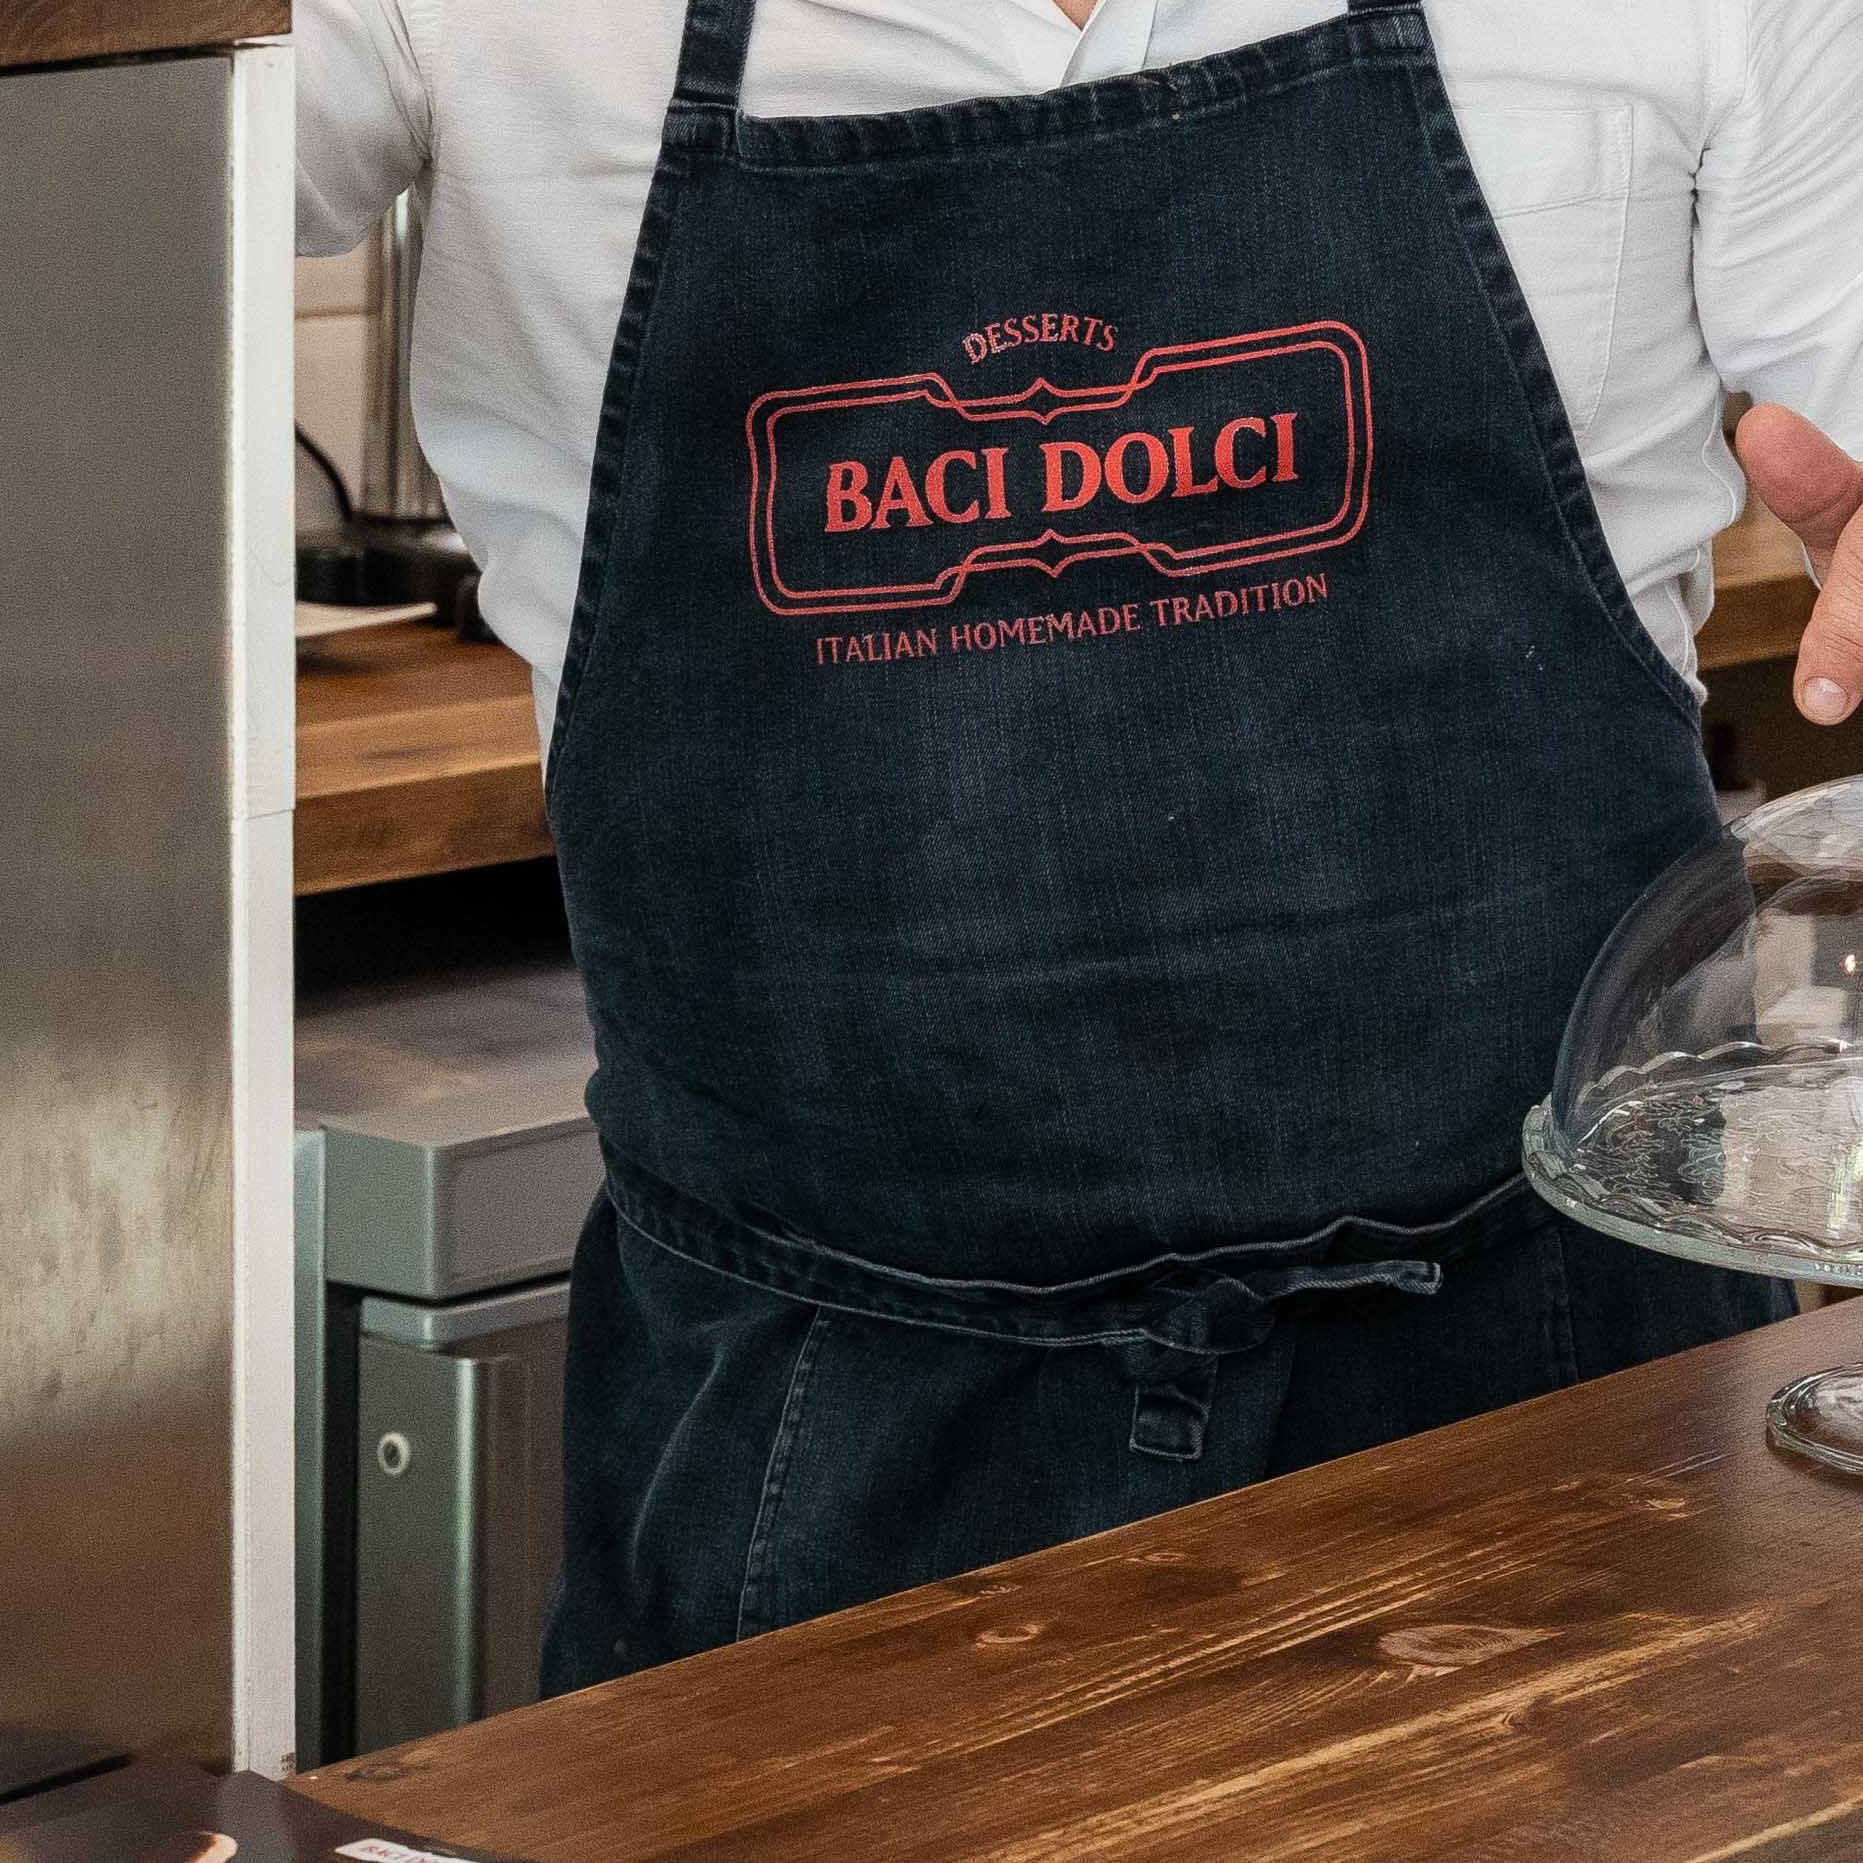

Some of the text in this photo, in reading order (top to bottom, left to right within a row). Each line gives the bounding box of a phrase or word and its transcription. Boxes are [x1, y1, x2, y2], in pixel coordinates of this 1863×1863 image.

[962, 312, 1120, 364] DESSERTS
[824, 413, 1299, 533] BACI DOLCI
[816, 573, 1329, 665] ITALIAN HOMEMADE TRADITION
